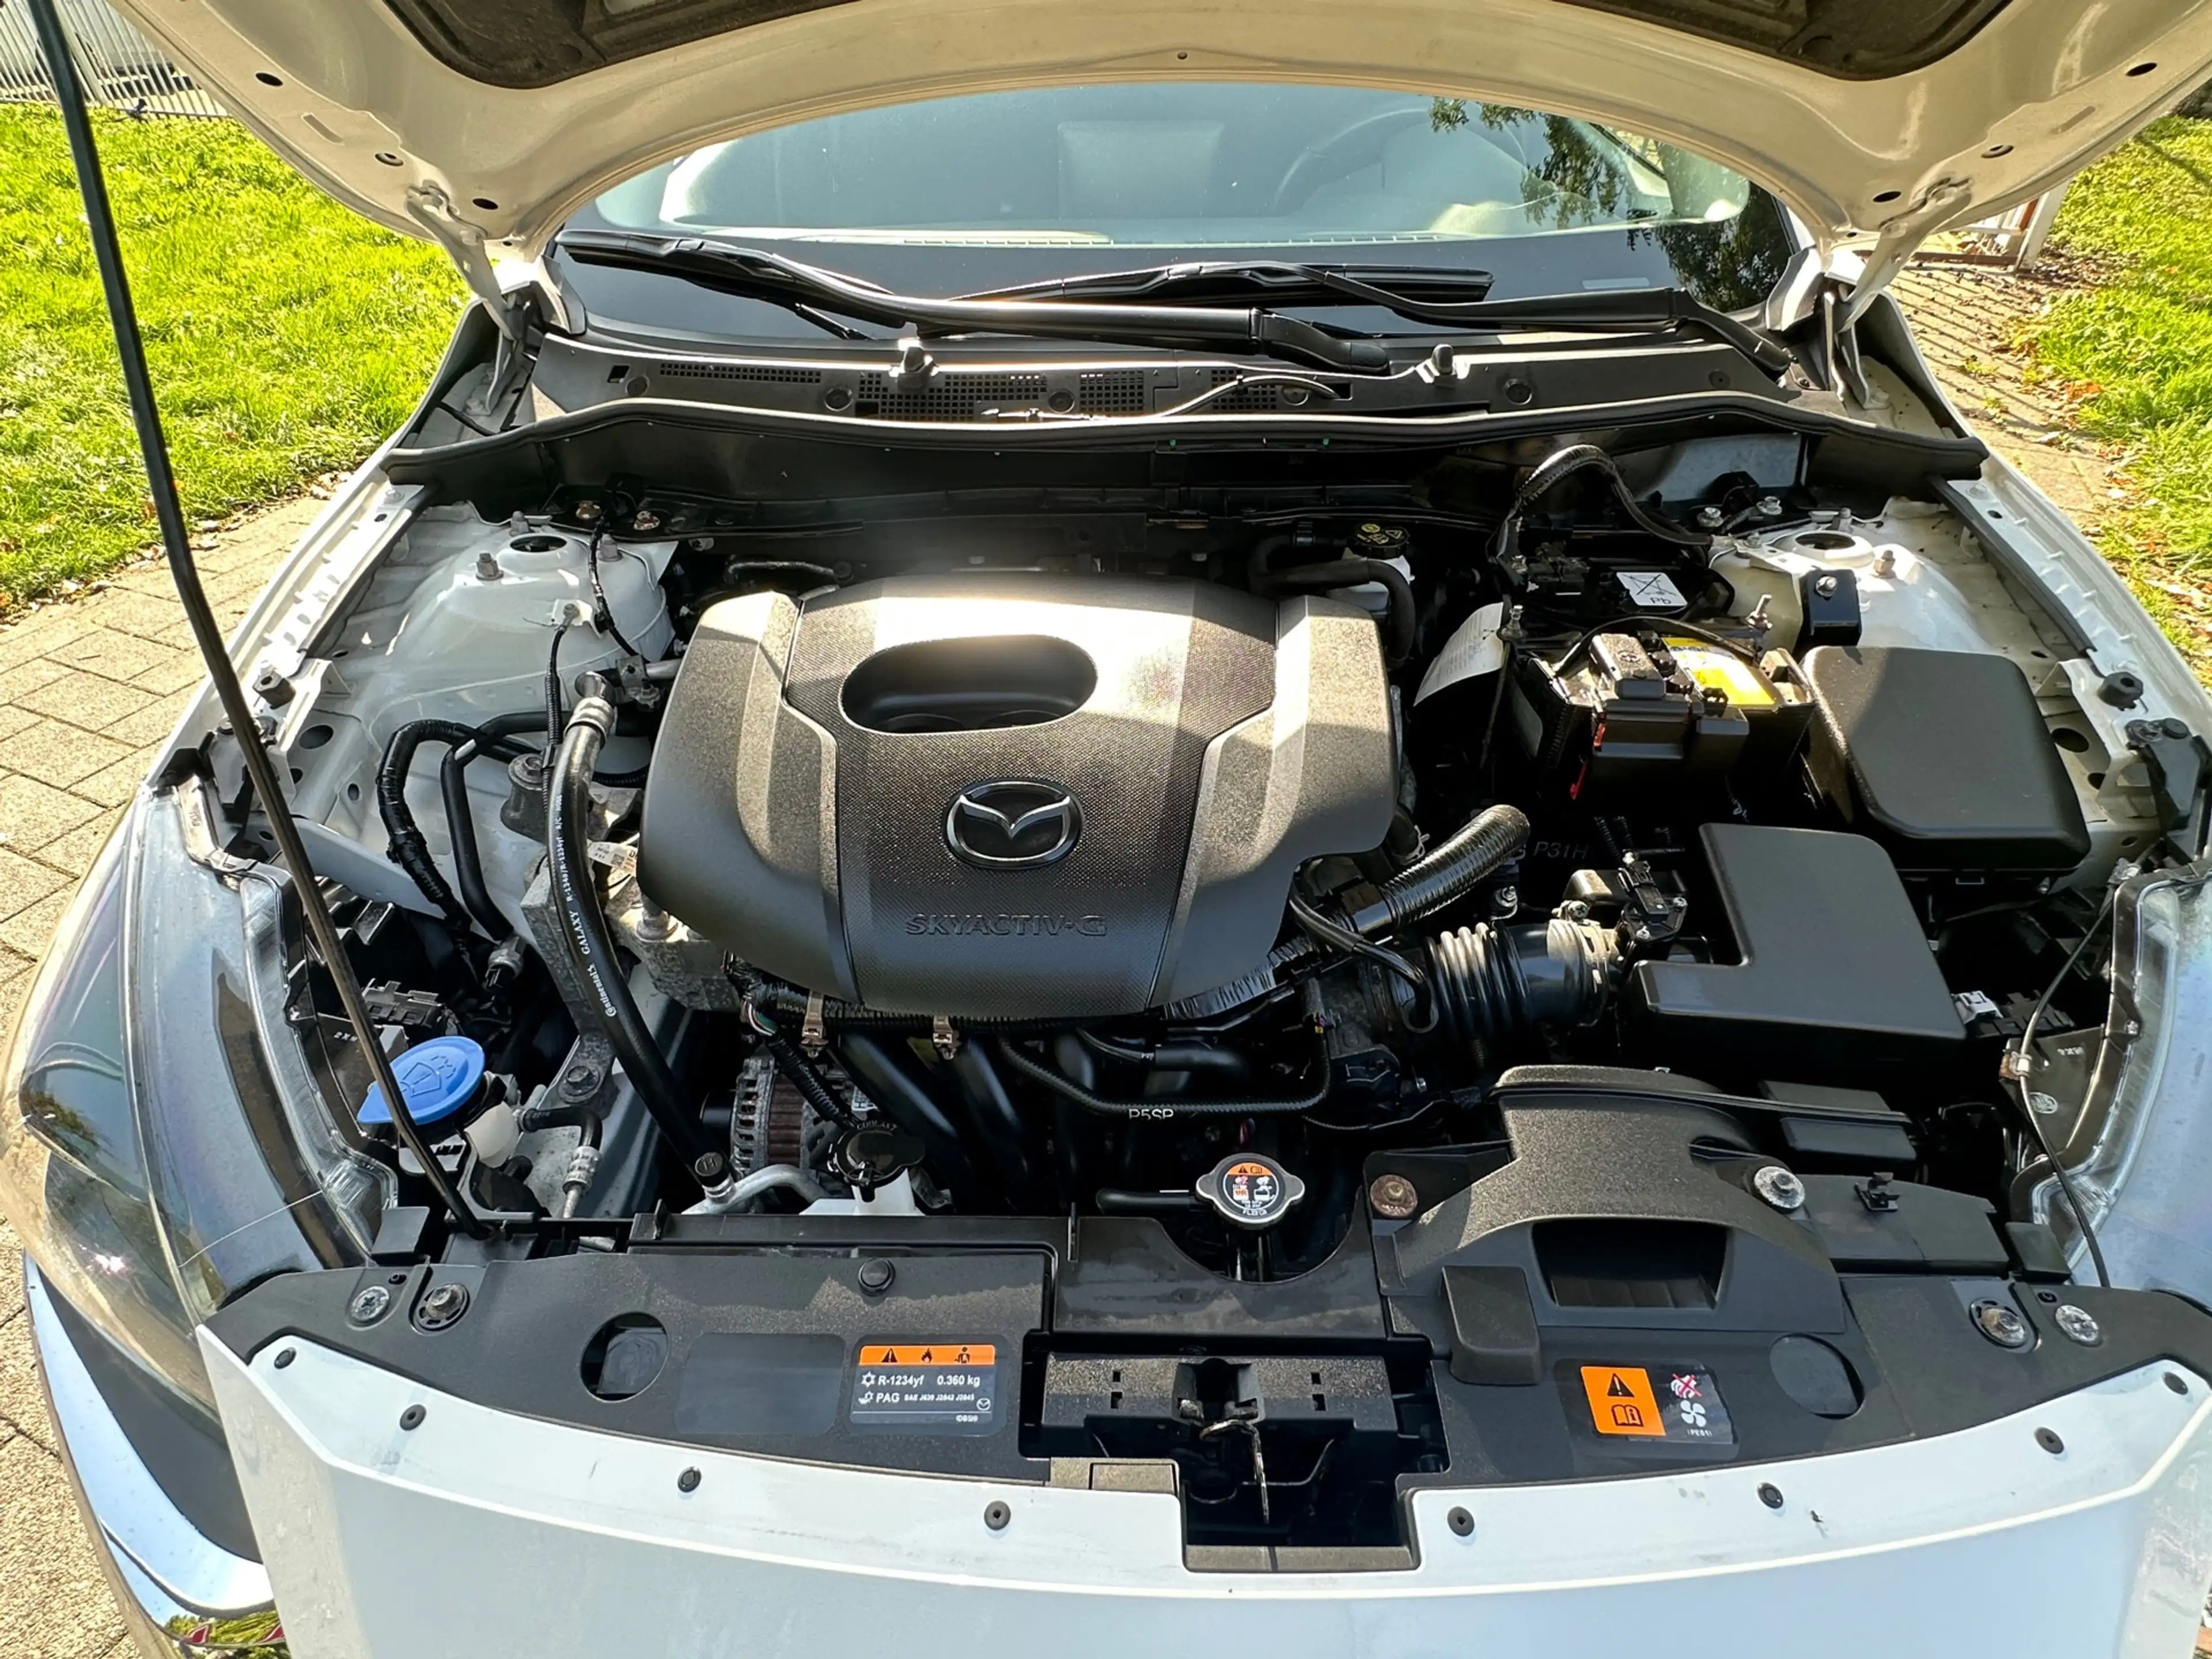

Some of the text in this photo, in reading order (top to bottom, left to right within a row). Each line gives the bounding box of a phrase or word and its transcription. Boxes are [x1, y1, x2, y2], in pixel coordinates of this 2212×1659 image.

[1533, 842, 1589, 859] P31H
[569, 910, 590, 955] GALAXY
[905, 914, 1107, 937] SKYACTIV-G
[878, 1374, 980, 1388] R-1234yf 0.360 kg
[876, 1392, 900, 1403] PAG
